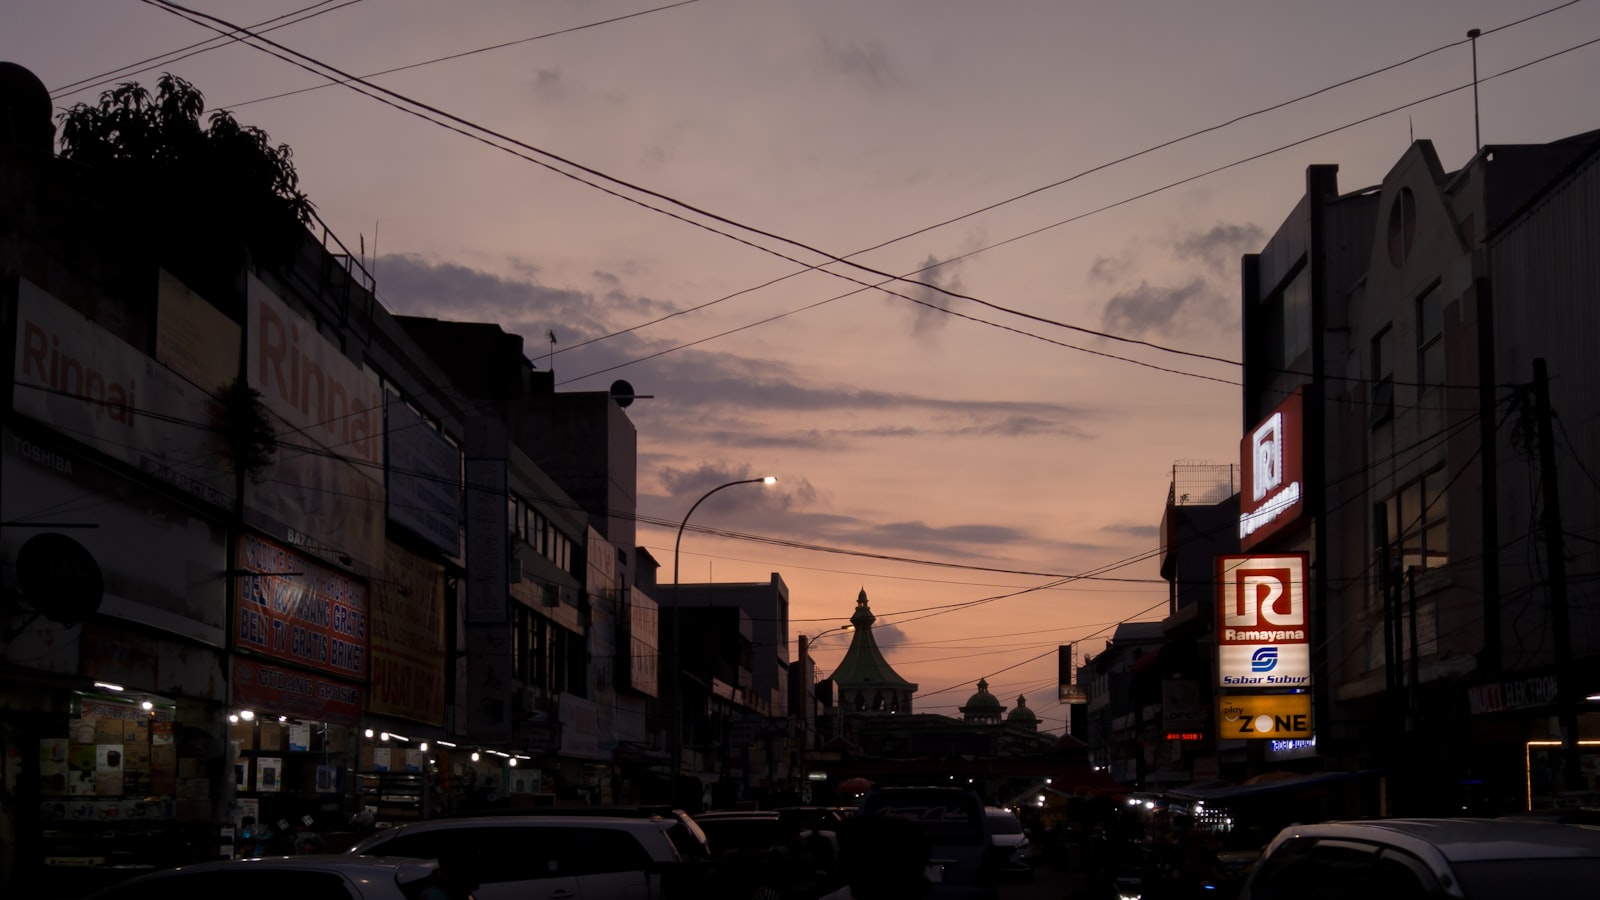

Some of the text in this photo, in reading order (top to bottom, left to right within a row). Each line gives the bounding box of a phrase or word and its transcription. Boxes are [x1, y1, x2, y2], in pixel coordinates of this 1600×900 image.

[22, 318, 137, 430] Rinnai
[257, 299, 379, 466] Rinnai
[11, 434, 74, 475] TOSHIBA
[287, 527, 321, 553] BAZAR
[242, 575, 270, 608] BELI
[333, 603, 366, 640] GRATIS
[240, 608, 365, 671] BELI TV GRATIS BRIKET
[1225, 628, 1305, 642] Ramayana
[257, 669, 313, 697] GUDANG
[1223, 675, 1307, 684] Sabar Subur
[1224, 706, 1244, 715] play
[1239, 714, 1307, 733] ZONE
